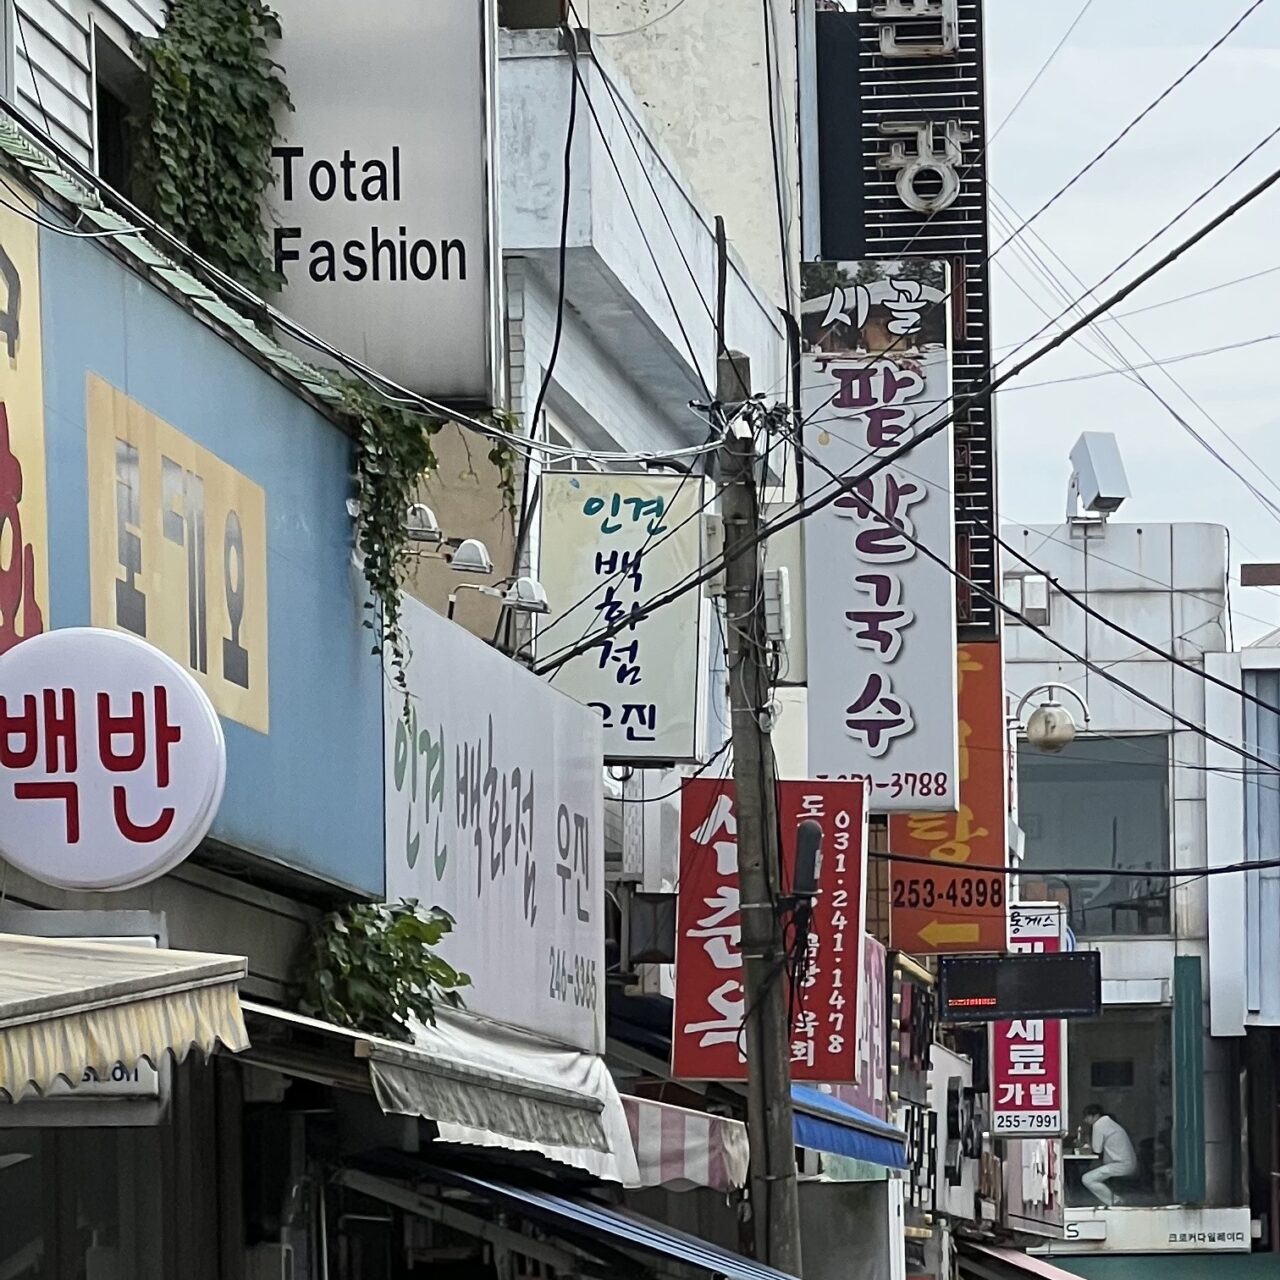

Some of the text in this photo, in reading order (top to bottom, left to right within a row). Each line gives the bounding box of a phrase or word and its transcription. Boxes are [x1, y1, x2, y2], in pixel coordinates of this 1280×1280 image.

[271, 146, 400, 201] Total
[272, 226, 467, 282] Fashion
[820, 279, 928, 335] 시골
[583, 493, 667, 535] 인견
[830, 360, 928, 758] 팥칼국수
[594, 550, 648, 686] 백화점
[0, 685, 182, 844] 백반
[556, 803, 590, 923] 우진
[893, 878, 1003, 908] 253-4398
[997, 1114, 1058, 1128] 255-7991
[998, 1083, 1056, 1106] 가발
